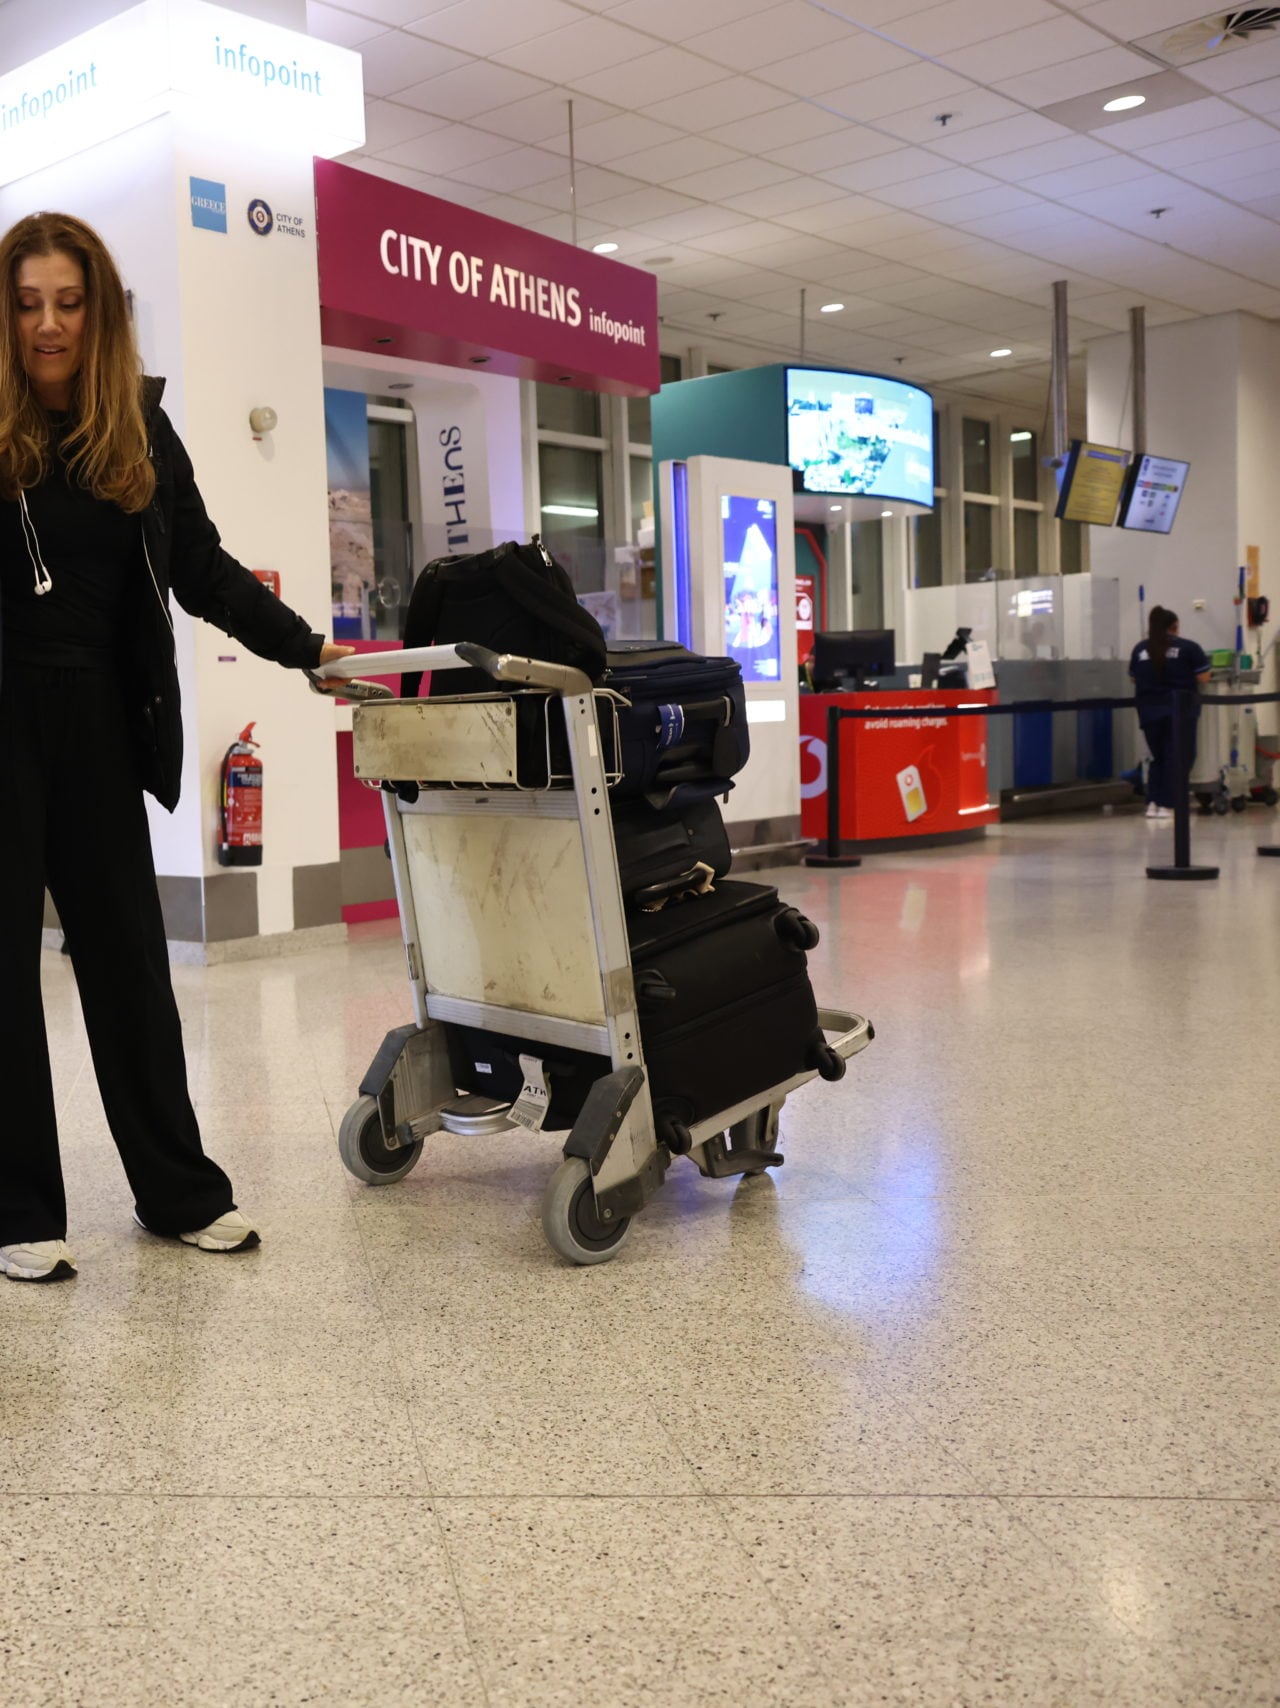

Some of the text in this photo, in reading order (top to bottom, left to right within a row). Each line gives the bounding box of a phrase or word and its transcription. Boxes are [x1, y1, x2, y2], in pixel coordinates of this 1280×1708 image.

[1, 61, 96, 130] infopoint
[215, 36, 322, 96] infopoint
[276, 213, 303, 226] CITY OF
[277, 225, 306, 238] ATHENS
[380, 229, 646, 346] CITY OF ATHENS infopoint
